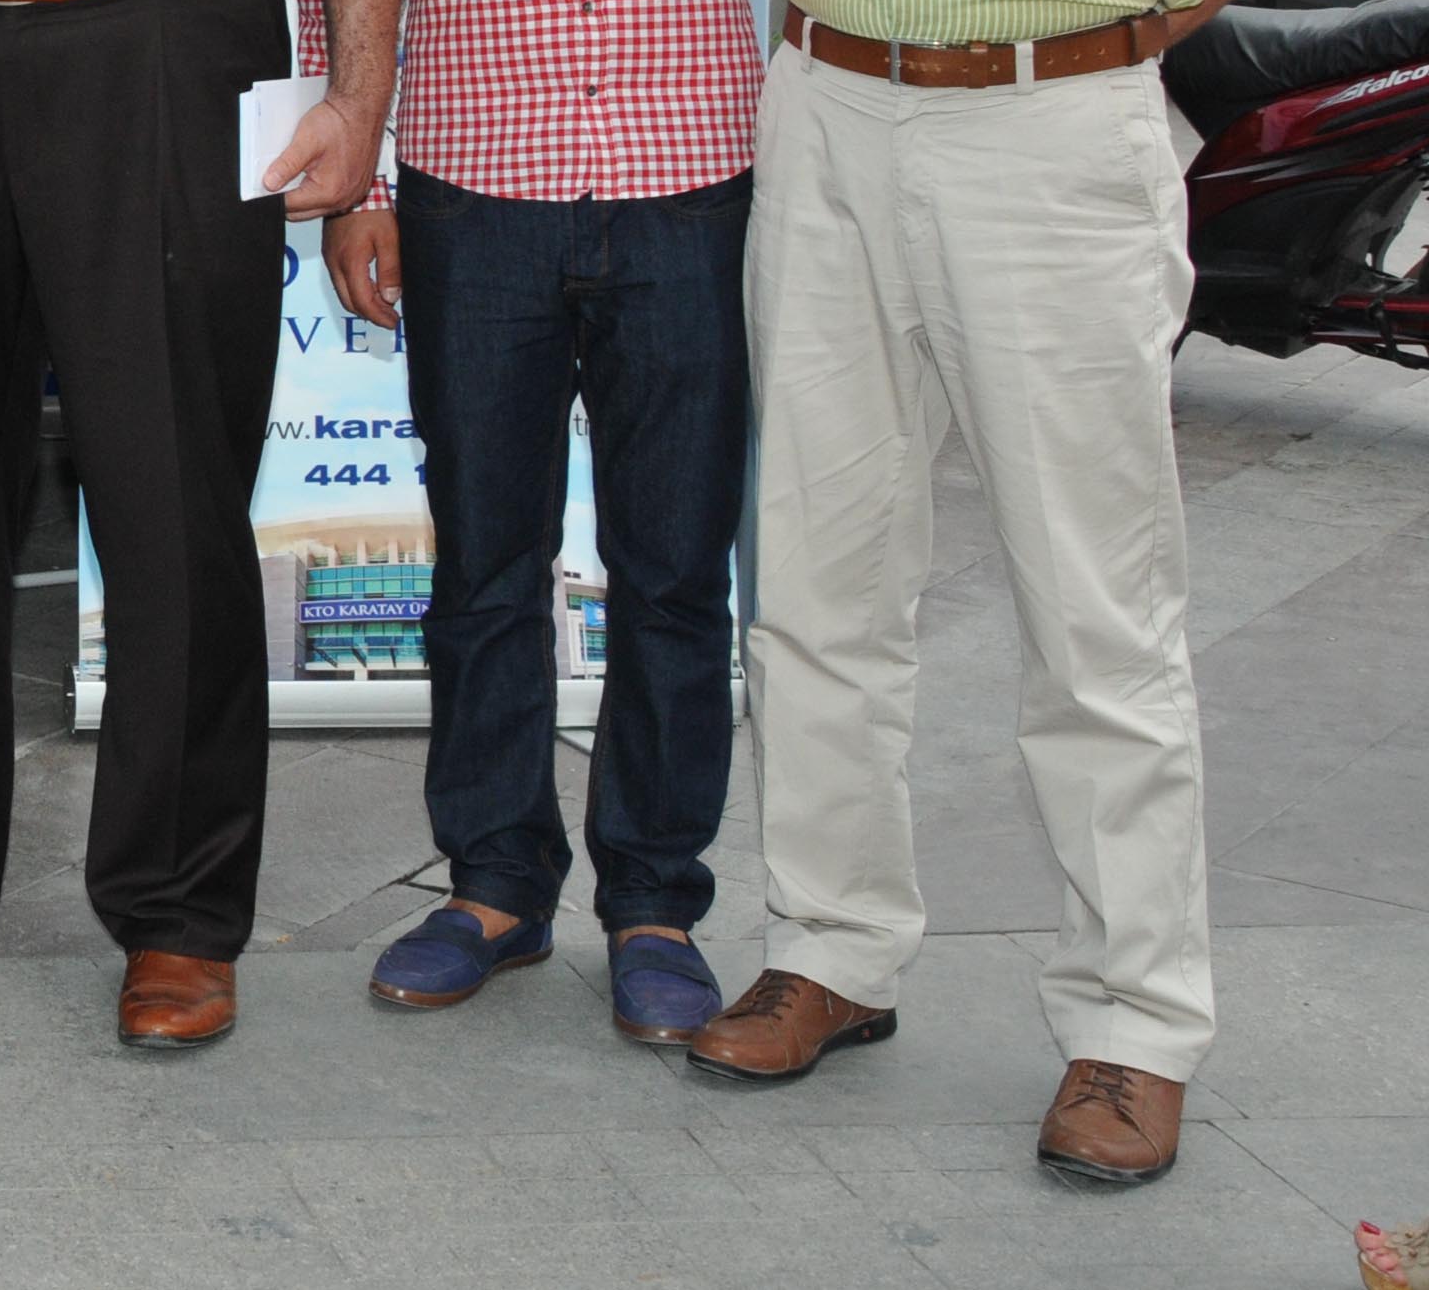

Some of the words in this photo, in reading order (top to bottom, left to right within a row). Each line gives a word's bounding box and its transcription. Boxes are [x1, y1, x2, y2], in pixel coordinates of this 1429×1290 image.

[304, 463, 392, 486] 444
[304, 606, 335, 619] KTO
[338, 603, 404, 617] KARATAY
